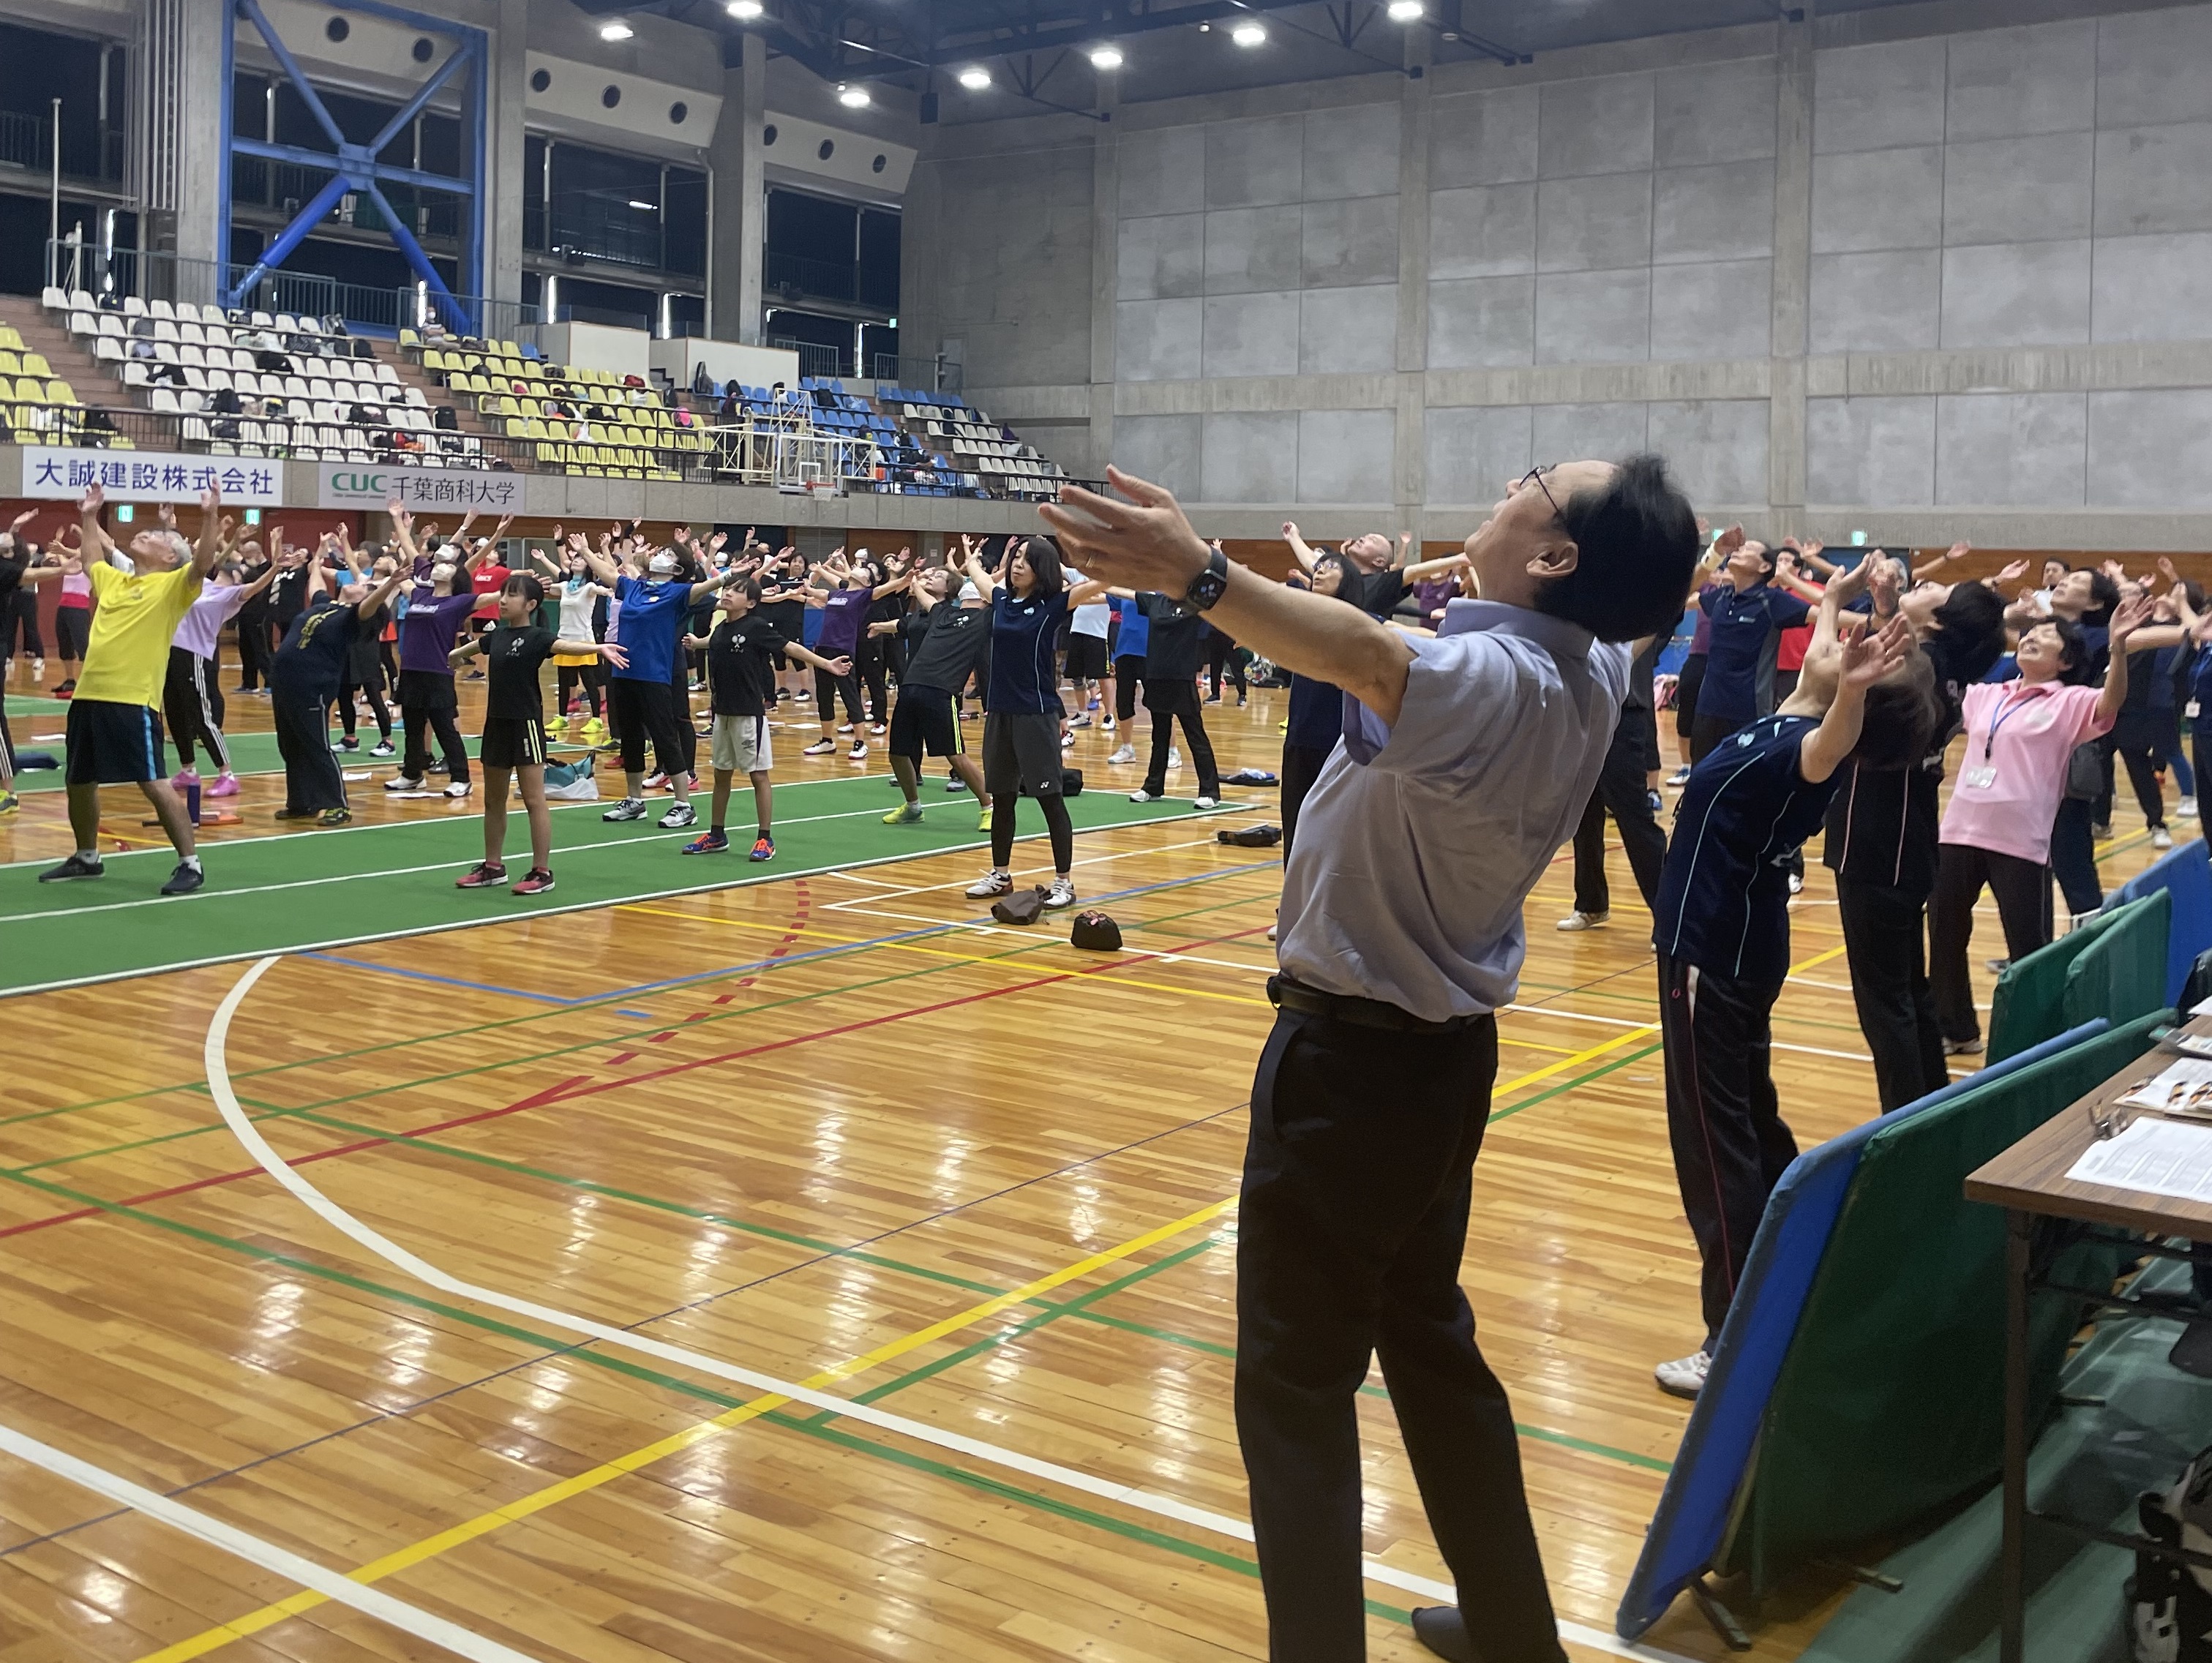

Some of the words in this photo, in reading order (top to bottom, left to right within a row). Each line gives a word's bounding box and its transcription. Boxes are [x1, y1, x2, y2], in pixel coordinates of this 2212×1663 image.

[35, 457, 274, 495] 大誠建設株式会社
[331, 473, 388, 492] CUC
[391, 476, 515, 505] 千葉商科大学
